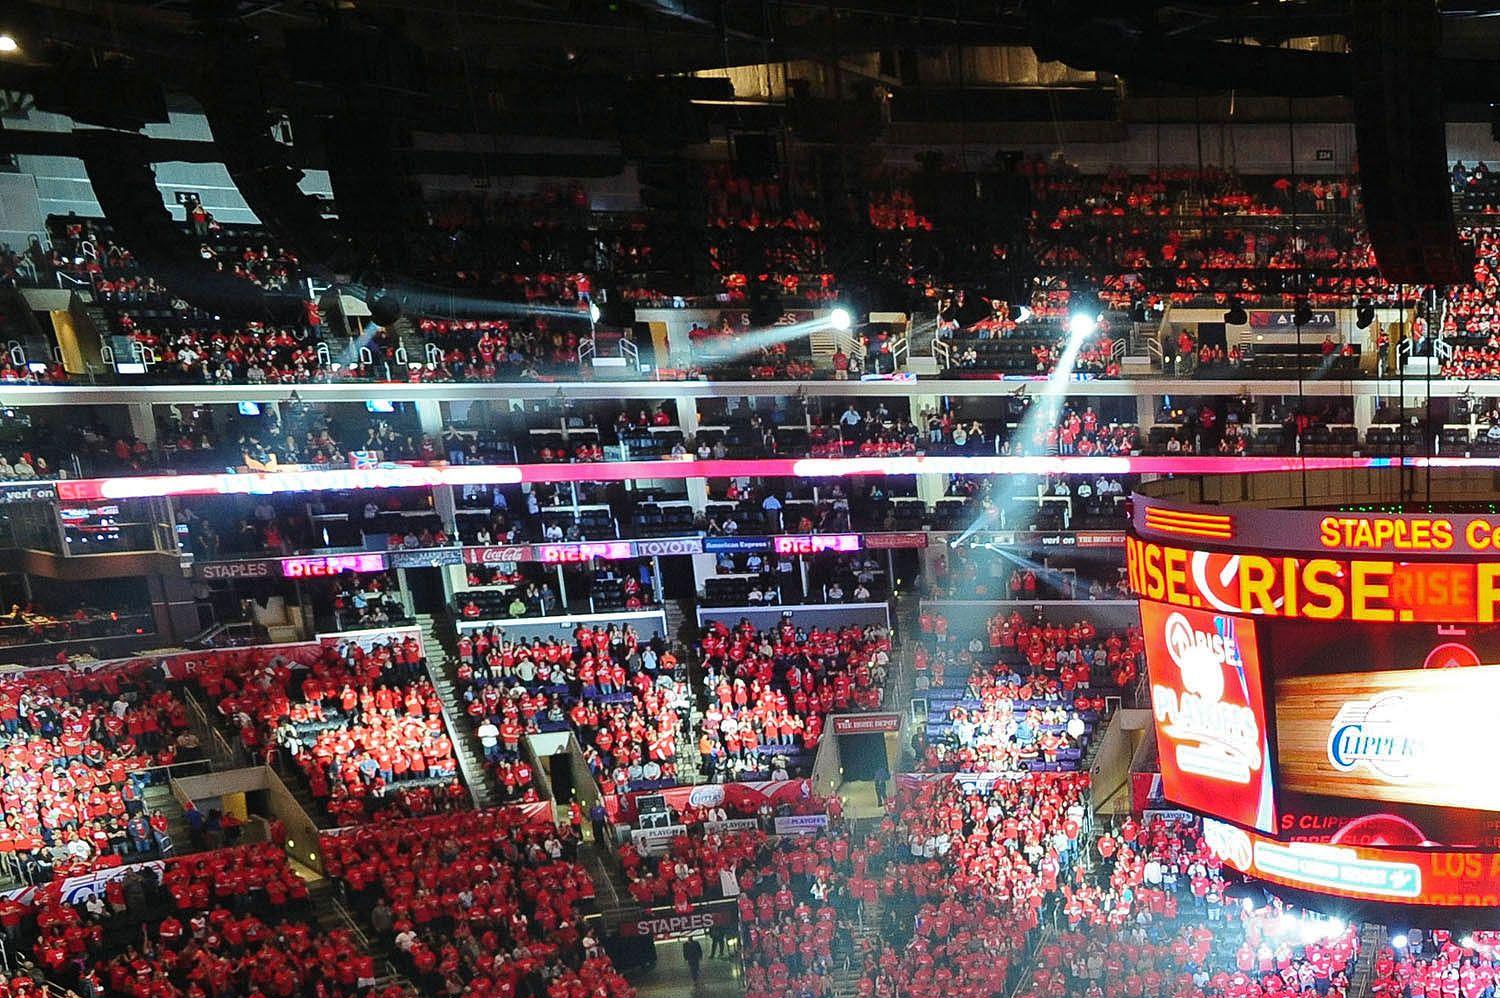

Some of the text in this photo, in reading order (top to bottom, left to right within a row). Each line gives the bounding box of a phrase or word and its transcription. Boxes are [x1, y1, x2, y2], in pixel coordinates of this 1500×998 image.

[1319, 516, 1454, 549] STAPLES
[638, 541, 703, 556] TOYOTA
[706, 541, 738, 550] American
[738, 540, 767, 550] Express
[203, 562, 268, 578] STAPLES
[1126, 536, 1201, 607] RISE.
[1239, 555, 1414, 622] RISE.
[875, 720, 899, 730] DEPOT
[790, 816, 827, 828] PLAYOFFS
[1431, 852, 1482, 878] LOS
[636, 913, 715, 935] STAPLES
